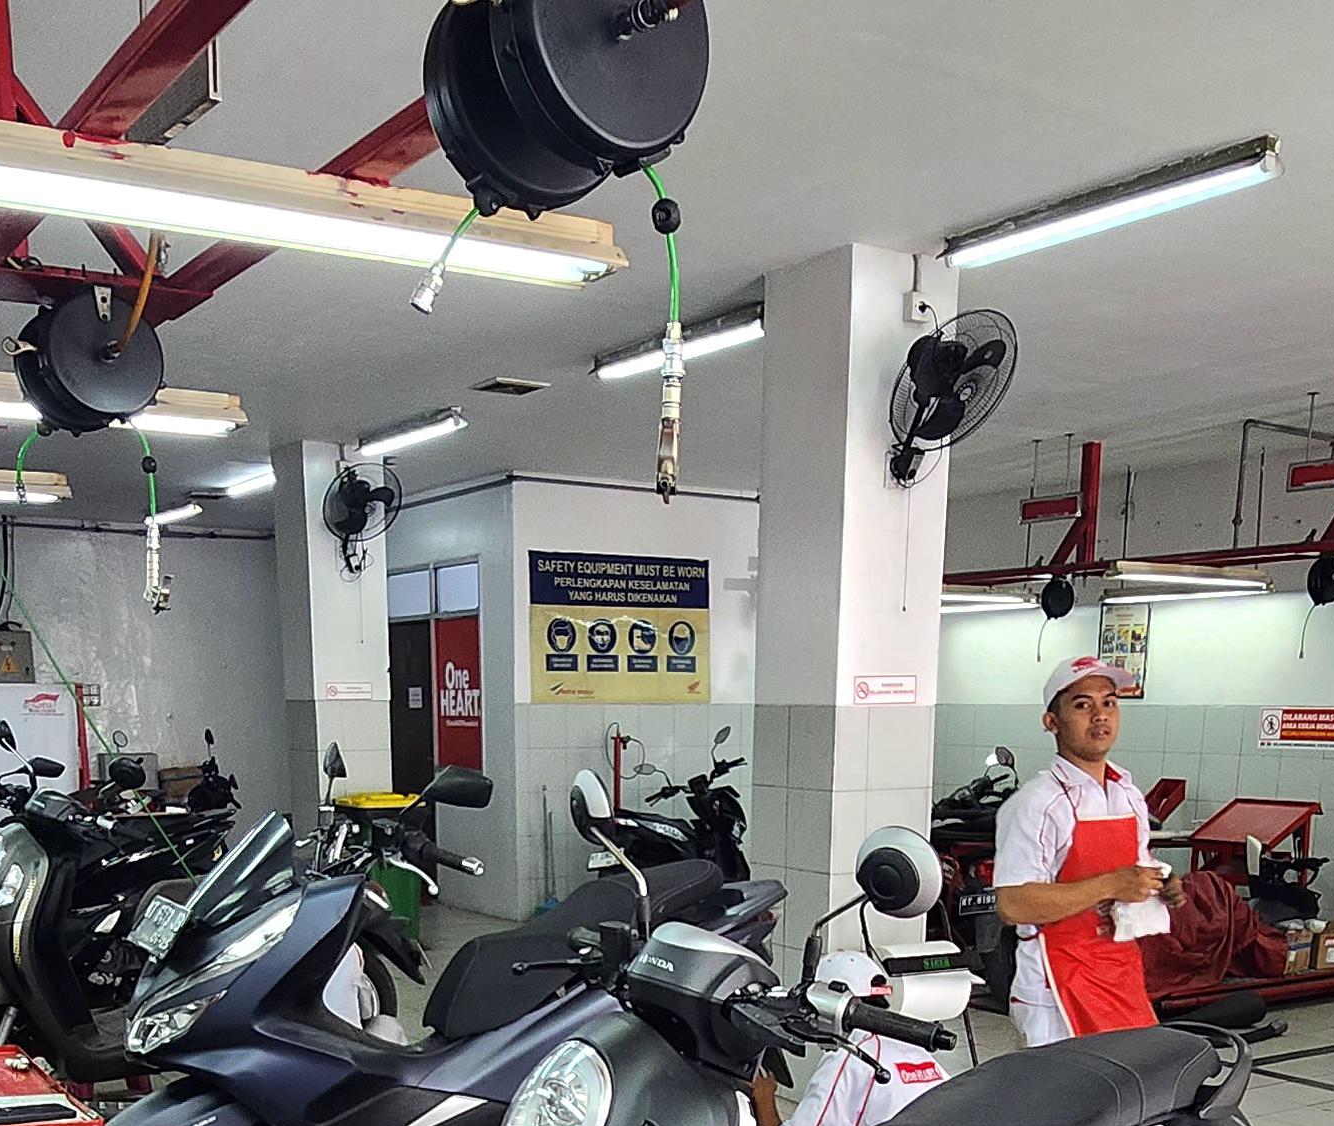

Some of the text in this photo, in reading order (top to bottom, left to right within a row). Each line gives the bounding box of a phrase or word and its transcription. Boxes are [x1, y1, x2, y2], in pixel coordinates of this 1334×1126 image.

[537, 559, 706, 579] SAFETY EQUIPMENT MUST BE WORN
[554, 577, 691, 591] PERLENGKAPAN KESELAMATAN
[568, 590, 678, 604] YANG HARUS DIKENAKAN
[445, 661, 470, 690] One
[1282, 713, 1318, 721] DILARANG
